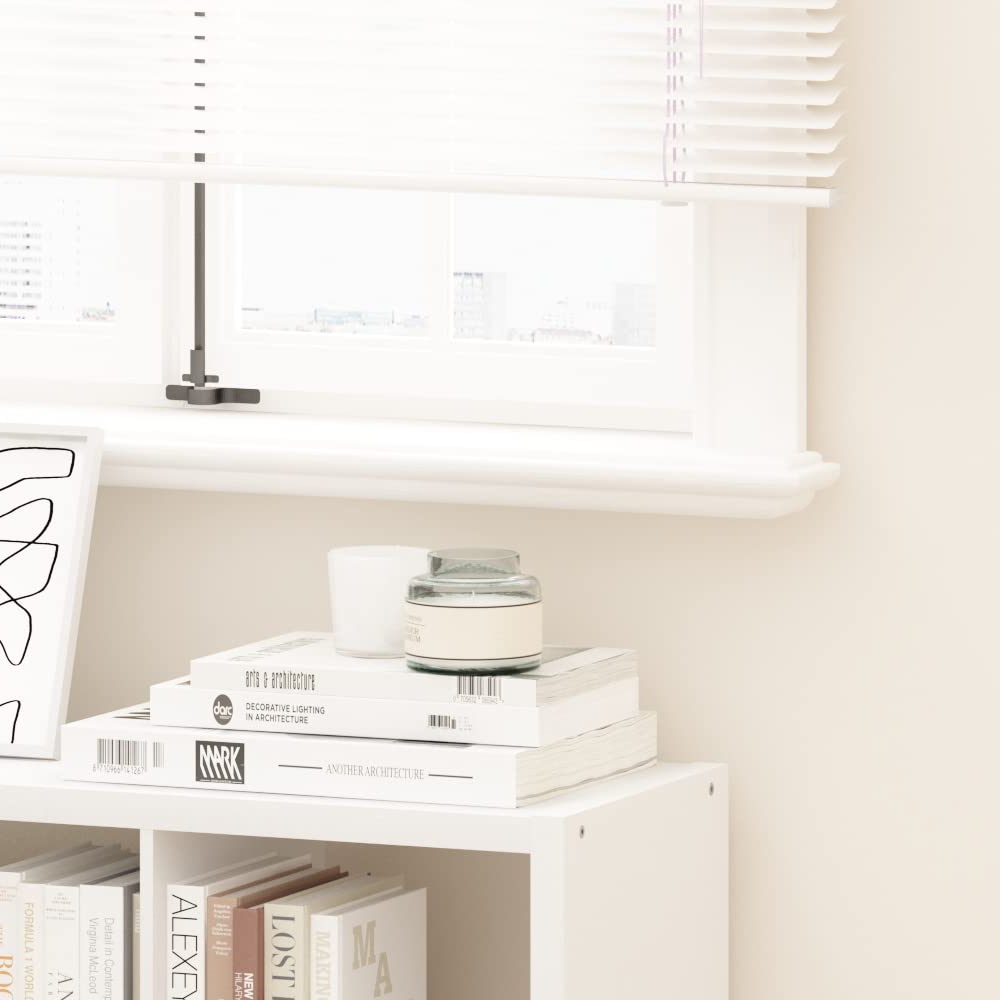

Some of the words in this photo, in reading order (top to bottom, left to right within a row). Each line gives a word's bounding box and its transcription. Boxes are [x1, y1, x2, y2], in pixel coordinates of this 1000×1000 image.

[246, 670, 260, 688] arts
[271, 671, 315, 691] architecture
[213, 701, 233, 716] darc
[246, 702, 291, 713] DECORATIVE
[292, 704, 325, 715] LIGHTING
[256, 714, 309, 724] ARCHITECTURE
[199, 744, 242, 781] MARK
[326, 764, 364, 777] ANOTHER
[365, 765, 425, 780] ARCHITECTURE
[24, 902, 34, 954] FORMULA
[86, 918, 99, 954] Virginia
[104, 918, 115, 946] Detail
[104, 948, 115, 957] in
[272, 915, 296, 988] LOST
[88, 956, 99, 994] McLeod
[244, 973, 254, 1000] NEW
